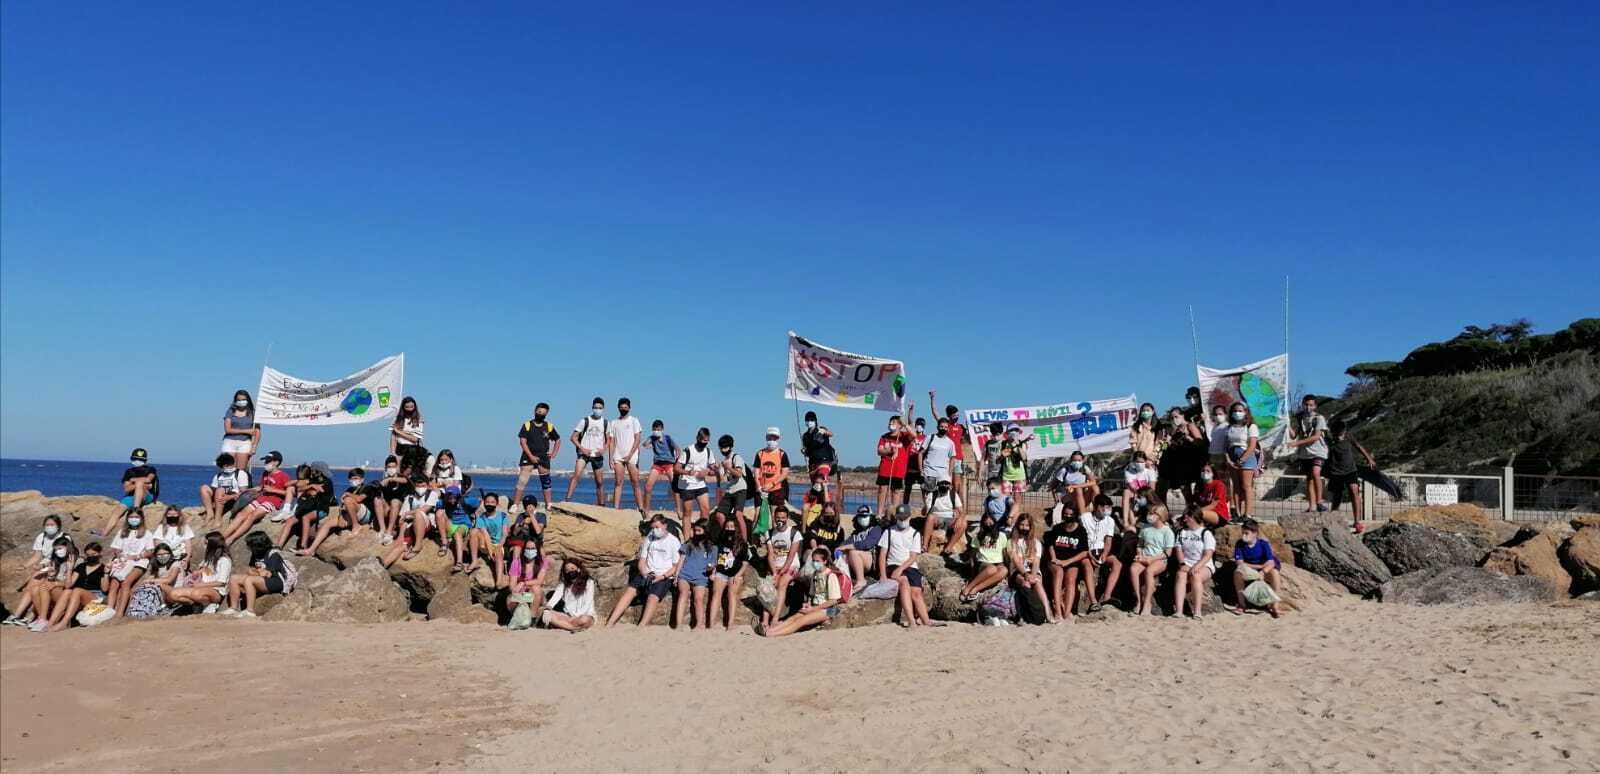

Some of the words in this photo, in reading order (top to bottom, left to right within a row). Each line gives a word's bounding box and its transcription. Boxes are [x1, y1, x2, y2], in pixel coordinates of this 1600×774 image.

[970, 410, 1008, 423] LLEVAS
[1013, 410, 1029, 420] TU
[1033, 424, 1065, 448] TU
